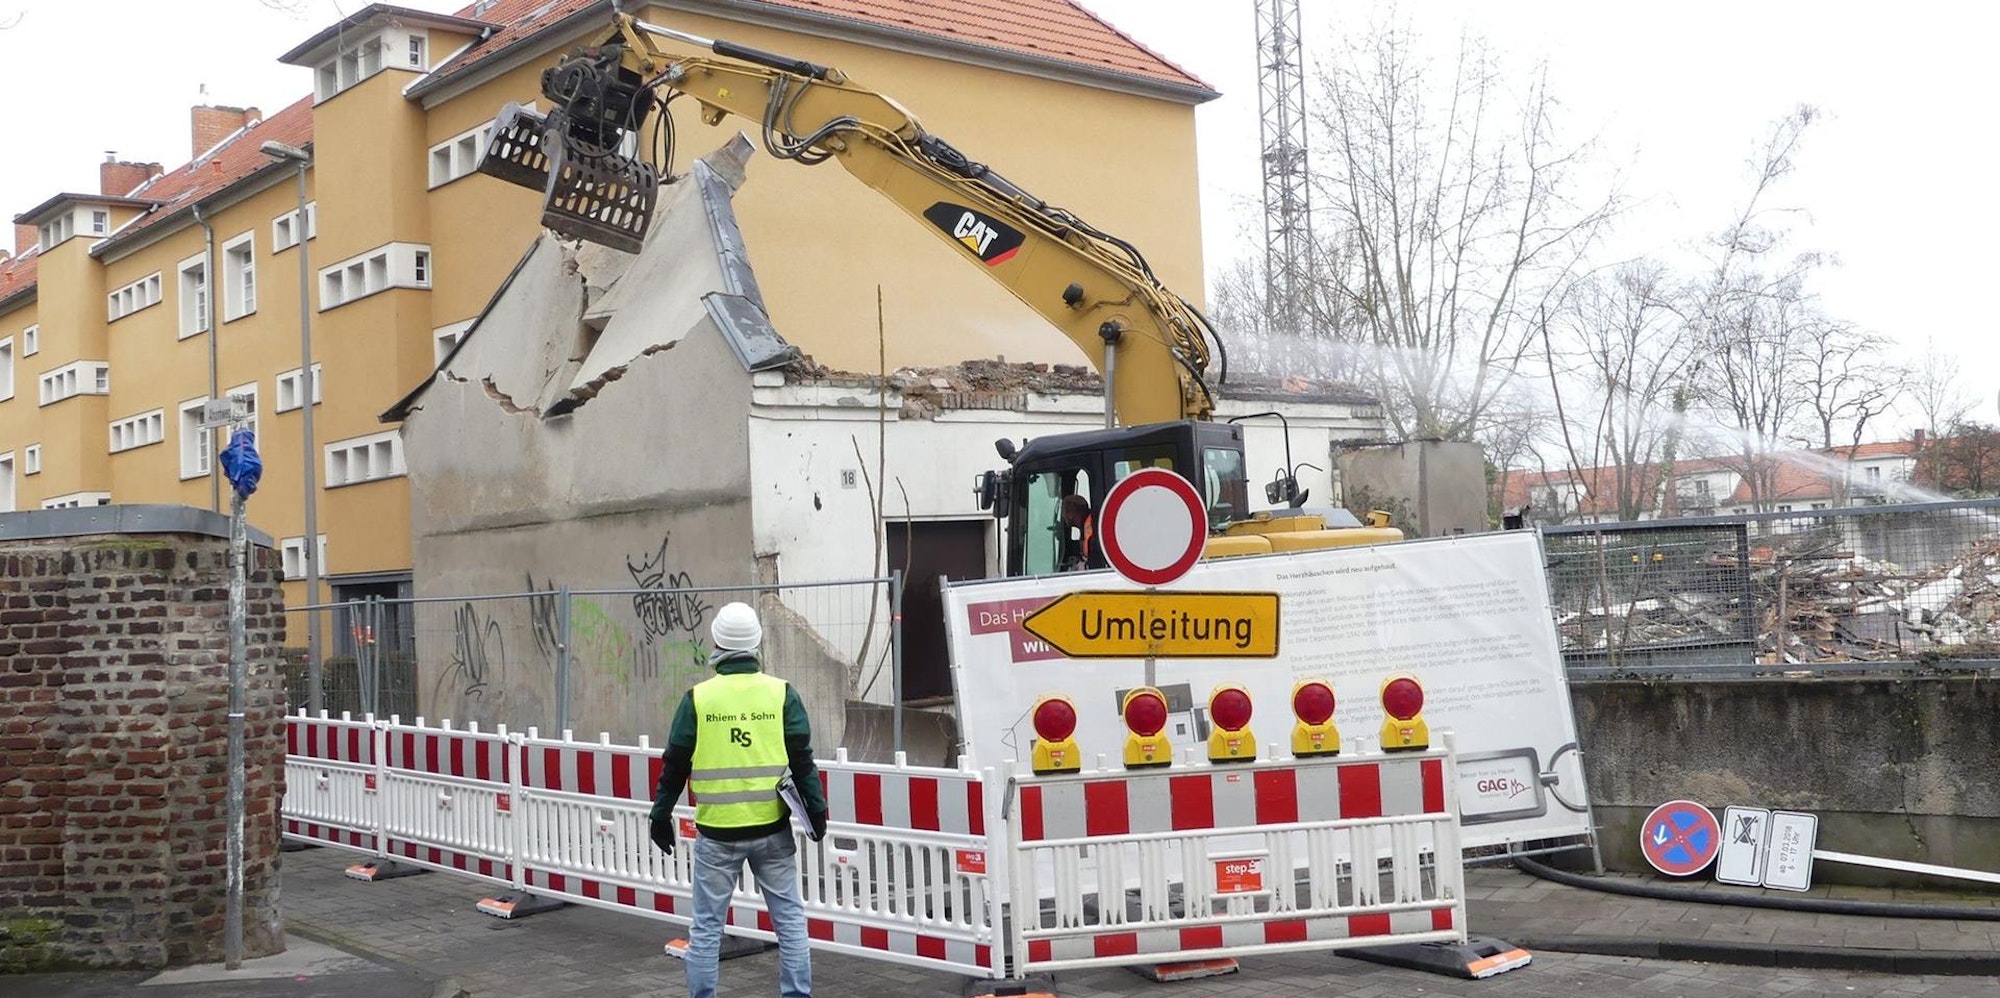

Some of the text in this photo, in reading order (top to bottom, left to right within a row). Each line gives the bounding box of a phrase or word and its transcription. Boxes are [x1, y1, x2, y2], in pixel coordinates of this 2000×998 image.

[954, 211, 998, 256] CAT
[842, 471, 854, 485] 18
[980, 611, 1008, 626] Das
[1081, 609, 1251, 648] Umleitung
[706, 713, 737, 722] Rhiem
[751, 712, 775, 720] Sohn
[730, 728, 752, 747] RS
[1477, 778, 1508, 793] GAG
